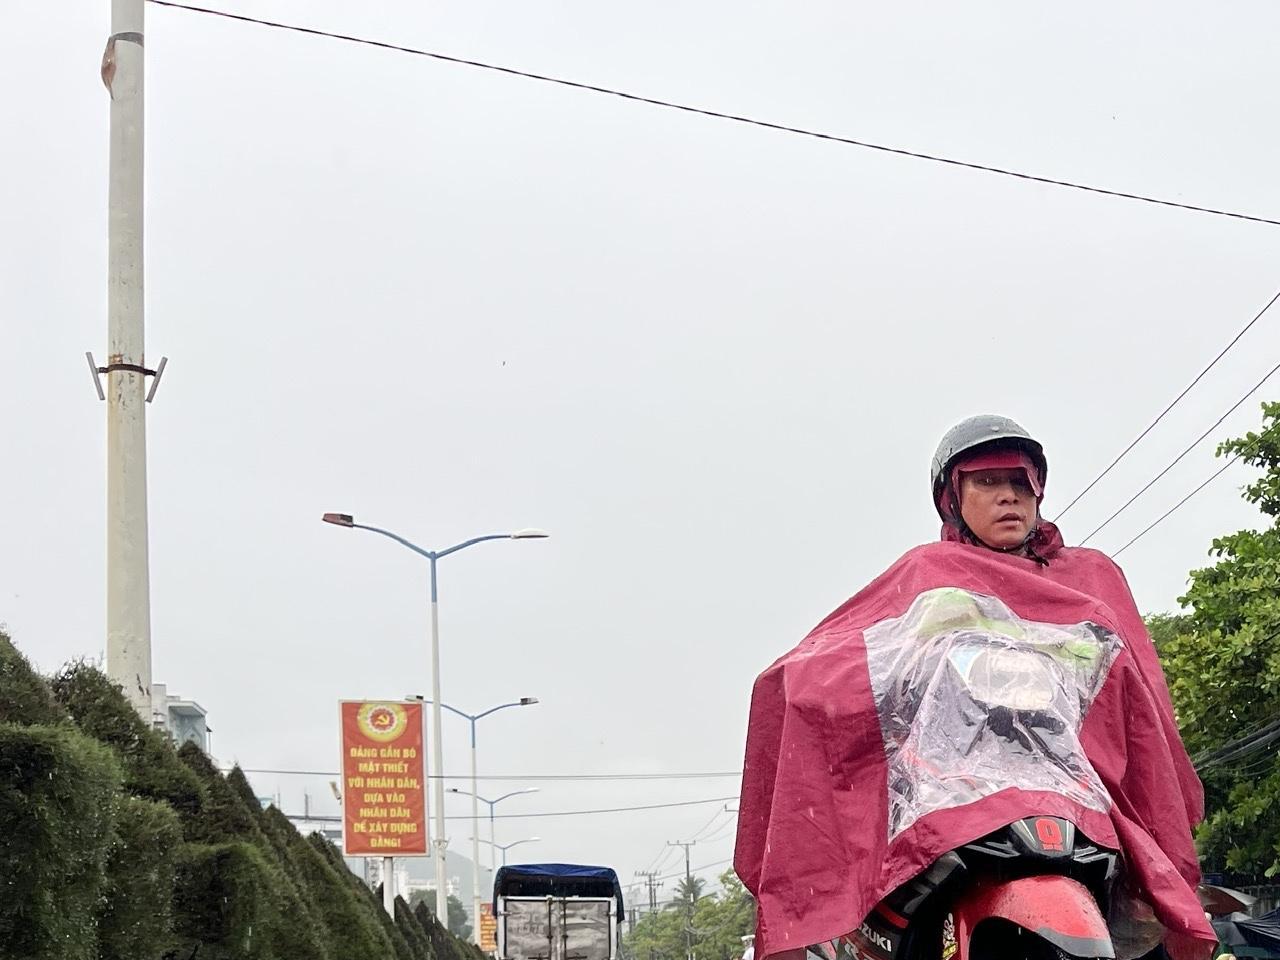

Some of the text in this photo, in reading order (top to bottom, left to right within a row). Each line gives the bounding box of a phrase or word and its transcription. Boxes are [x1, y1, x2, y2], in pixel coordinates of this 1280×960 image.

[359, 761, 409, 774] MẬT THIẾT
[366, 776, 395, 788] NHÂN
[364, 793, 405, 805] DỰA VÀO
[359, 806, 410, 818] NHÂN DÂN
[369, 820, 388, 833] XÂY
[858, 922, 892, 953] ZUKI
